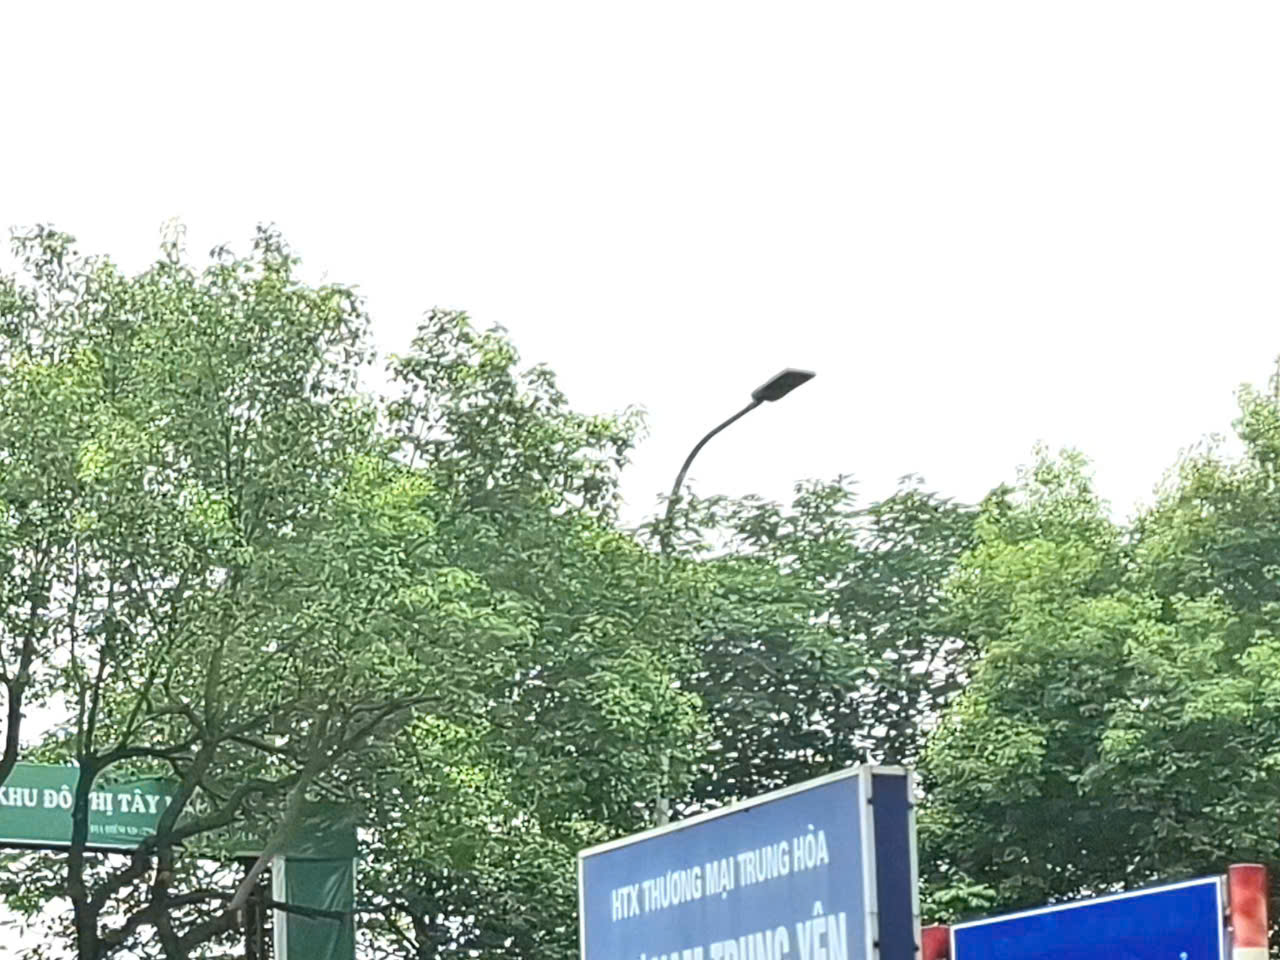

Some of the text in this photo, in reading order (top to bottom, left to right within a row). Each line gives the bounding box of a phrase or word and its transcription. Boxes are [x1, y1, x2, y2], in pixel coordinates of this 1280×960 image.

[43, 784, 73, 809] ĐÔ
[118, 788, 160, 814] TÂY
[612, 824, 830, 922] HTX THƯƠNG MẠI TRUNG HÒA
